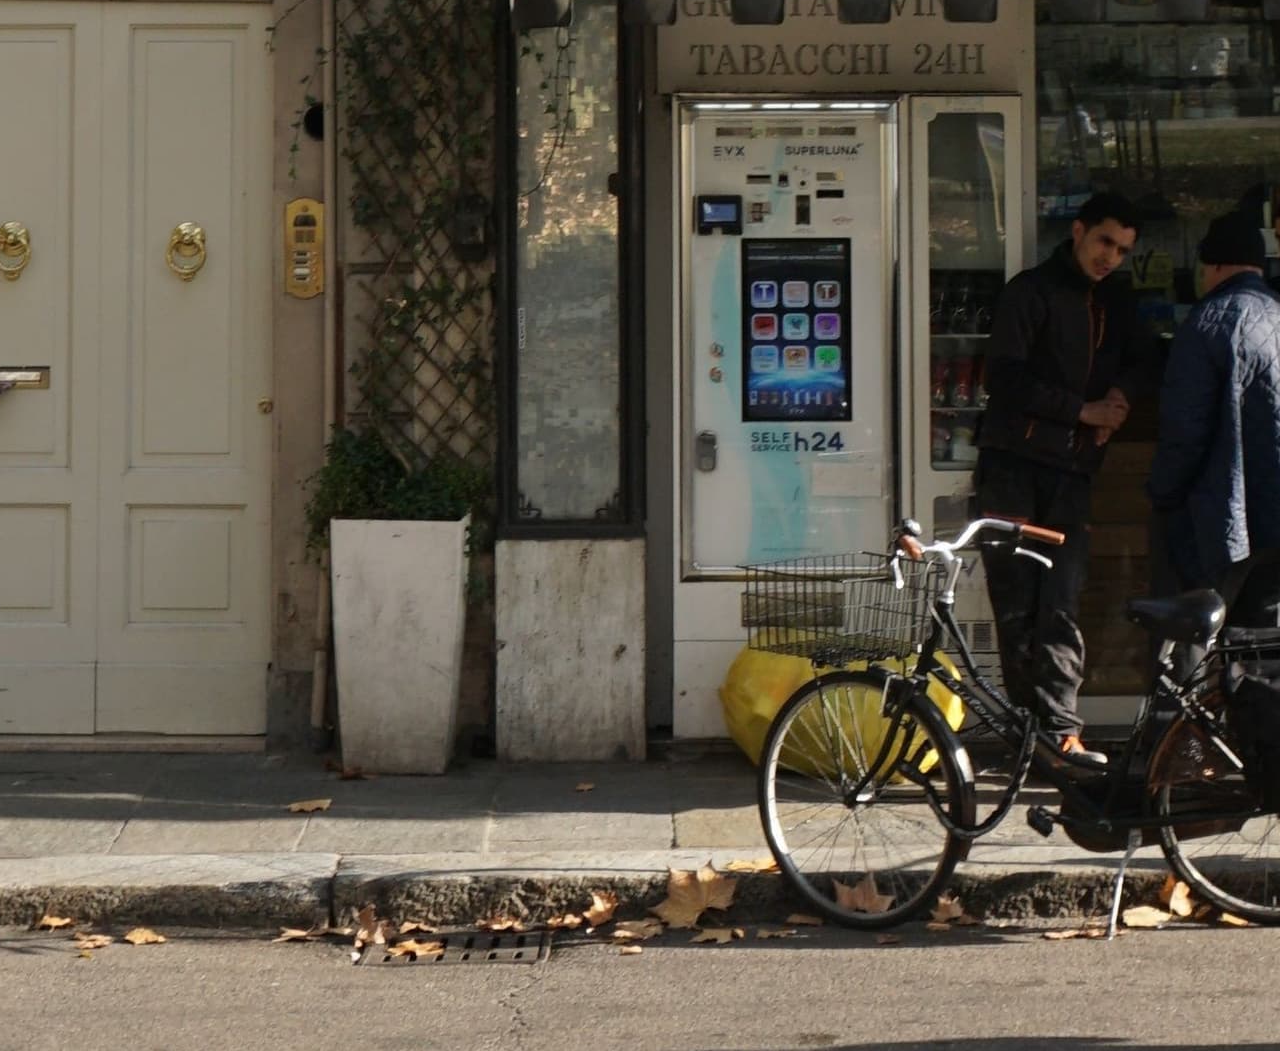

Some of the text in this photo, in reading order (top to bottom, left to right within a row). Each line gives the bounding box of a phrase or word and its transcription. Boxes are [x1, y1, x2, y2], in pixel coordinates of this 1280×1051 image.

[689, 43, 985, 76] TABACCHI 24H
[785, 143, 865, 156] SUPERLUNA
[751, 432, 792, 442] SELF
[794, 431, 844, 451] h24
[751, 443, 792, 451] SERVICE
